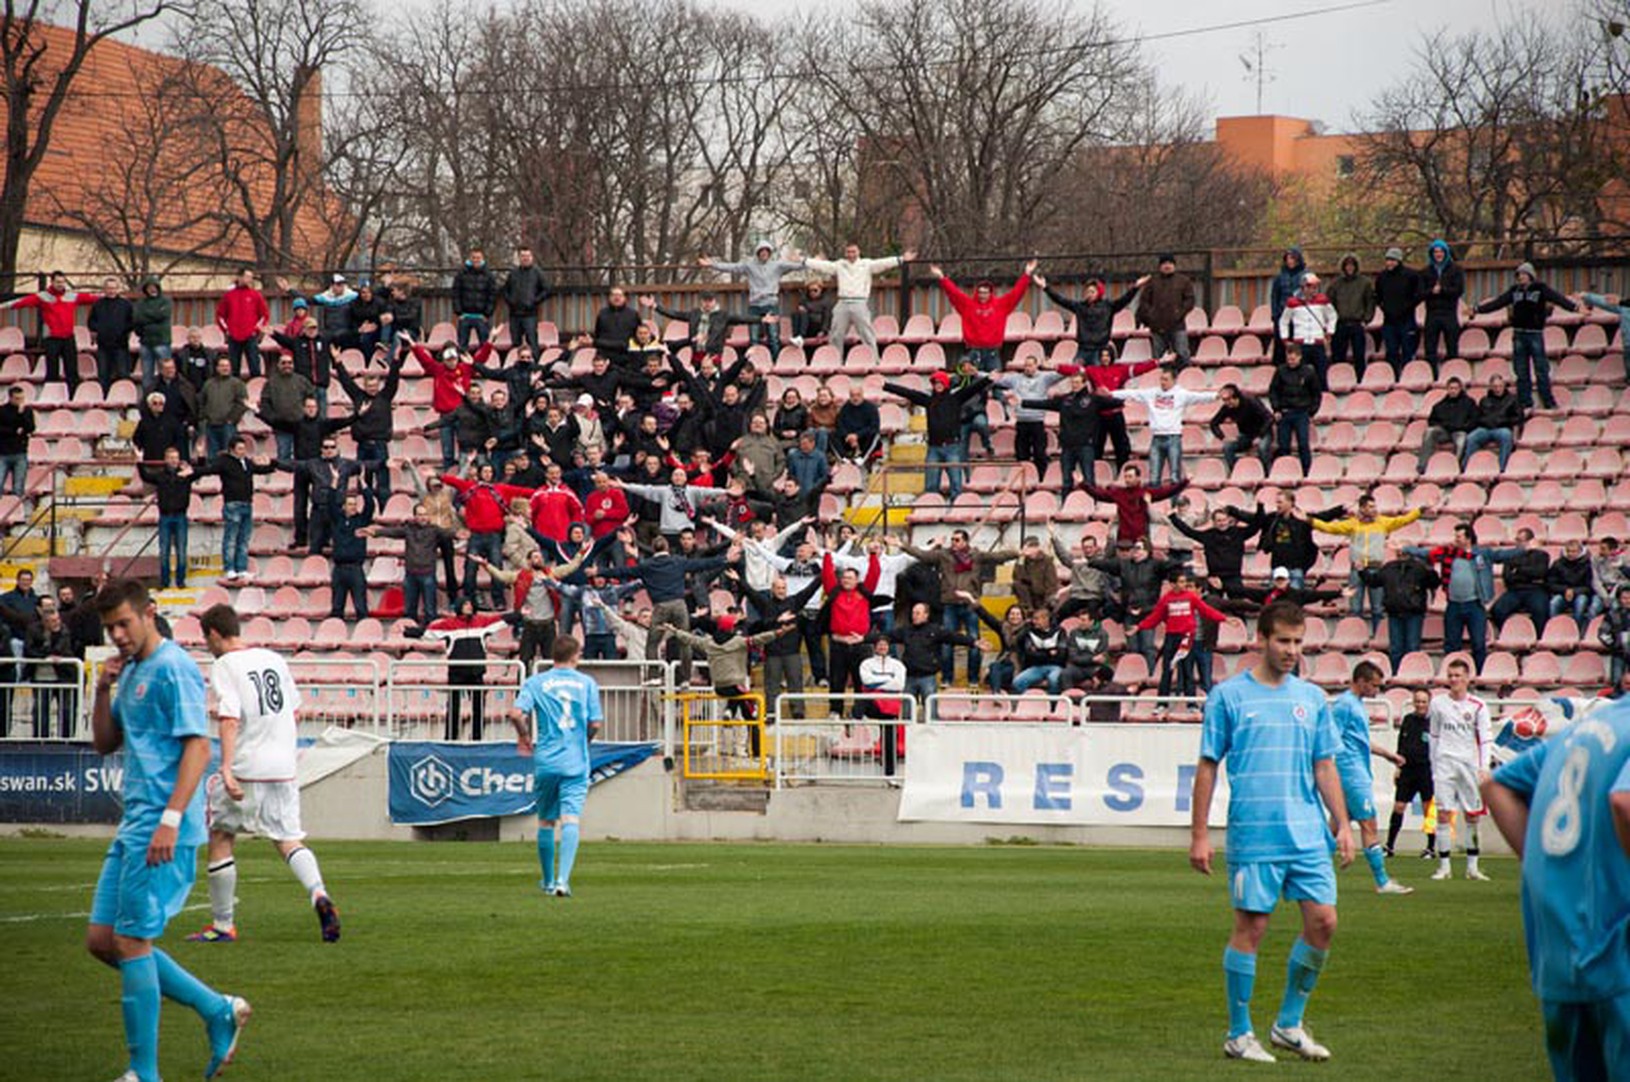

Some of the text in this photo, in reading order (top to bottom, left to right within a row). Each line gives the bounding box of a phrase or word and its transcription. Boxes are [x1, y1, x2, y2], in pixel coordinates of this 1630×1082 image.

[247, 668, 284, 716] 18
[0, 769, 76, 791] swan.sk
[1541, 747, 1590, 857] 8
